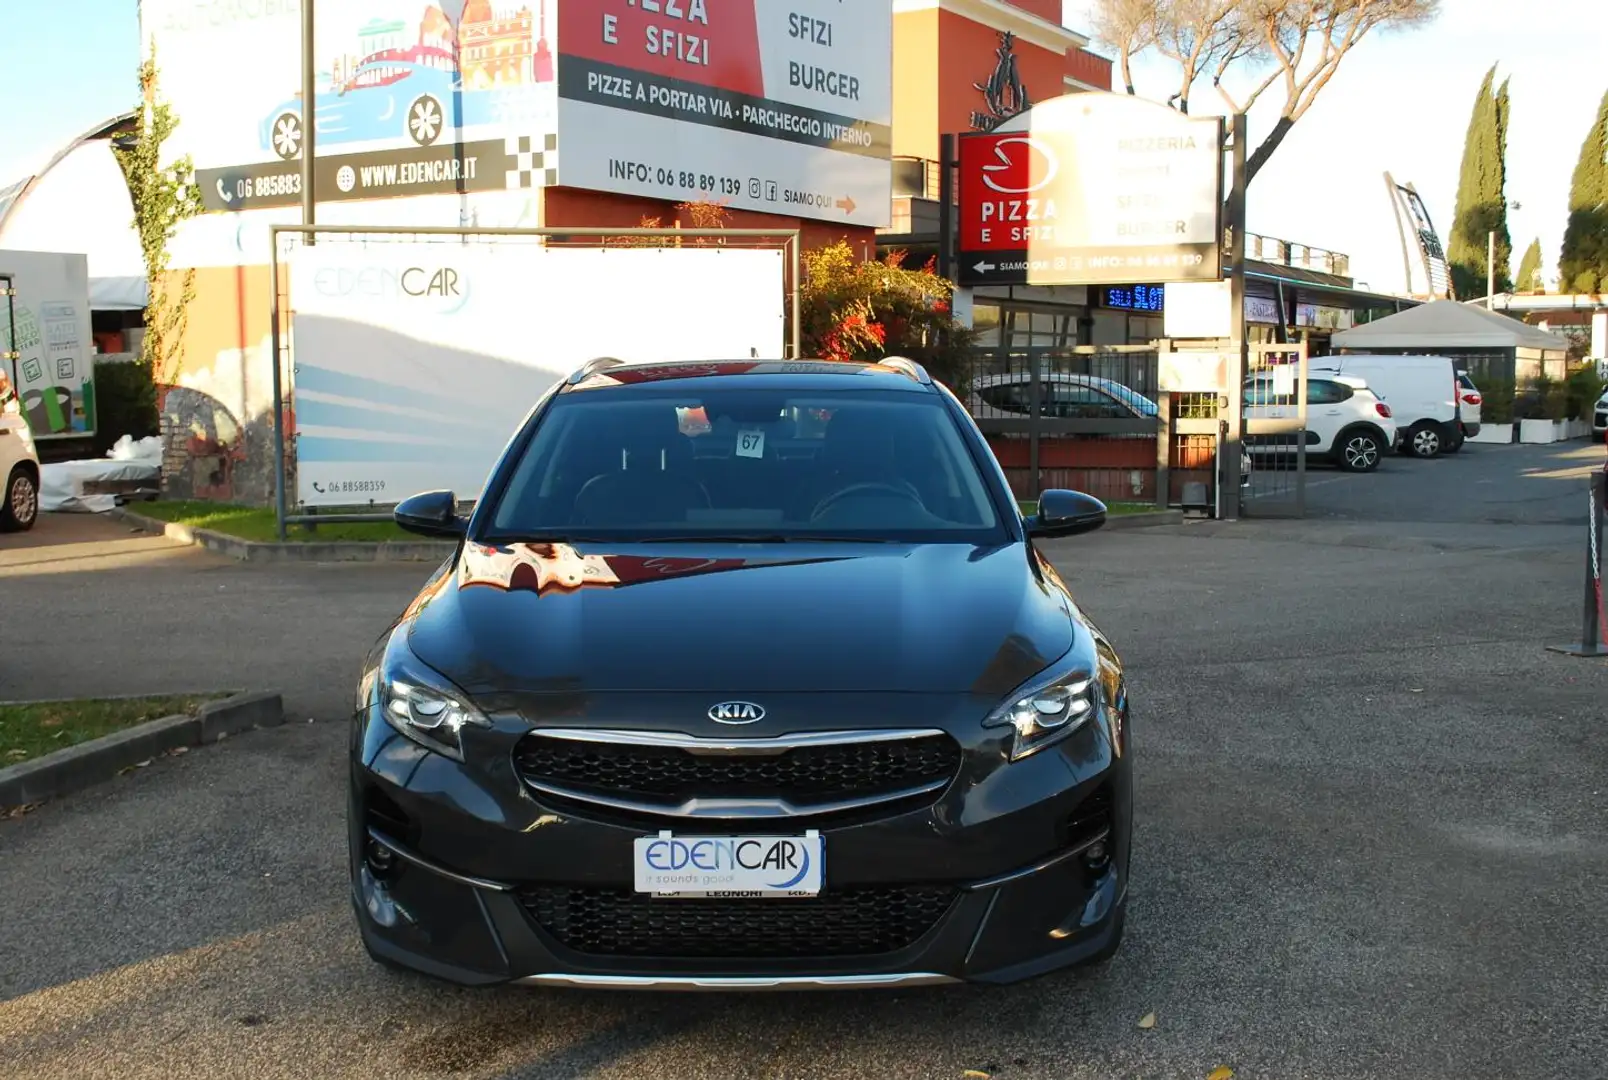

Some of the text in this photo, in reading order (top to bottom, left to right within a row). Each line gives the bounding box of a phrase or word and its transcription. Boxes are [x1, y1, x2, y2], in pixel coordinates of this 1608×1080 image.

[604, 13, 708, 65] E SFIZI
[788, 12, 832, 47] SFIZI
[789, 61, 859, 101] BURGER
[588, 72, 872, 147] PIZZE A PORTAR VIA PARCHEGGIO INTERNO
[360, 157, 479, 187] WWW.EDENCAR.IT
[609, 158, 741, 195] INFO: 06 88 89 139
[237, 173, 302, 198] 06 885883
[784, 189, 832, 208] SIAMO QUI
[982, 199, 1057, 222] PIZZA
[981, 228, 991, 242] E
[1000, 261, 1029, 271] SIAMO
[314, 266, 460, 297] EDENCAR
[742, 434, 760, 450] 67
[328, 482, 340, 492] 06
[718, 704, 757, 718] KIA
[646, 840, 798, 870] EDENCAR
[656, 873, 698, 884] sounds
